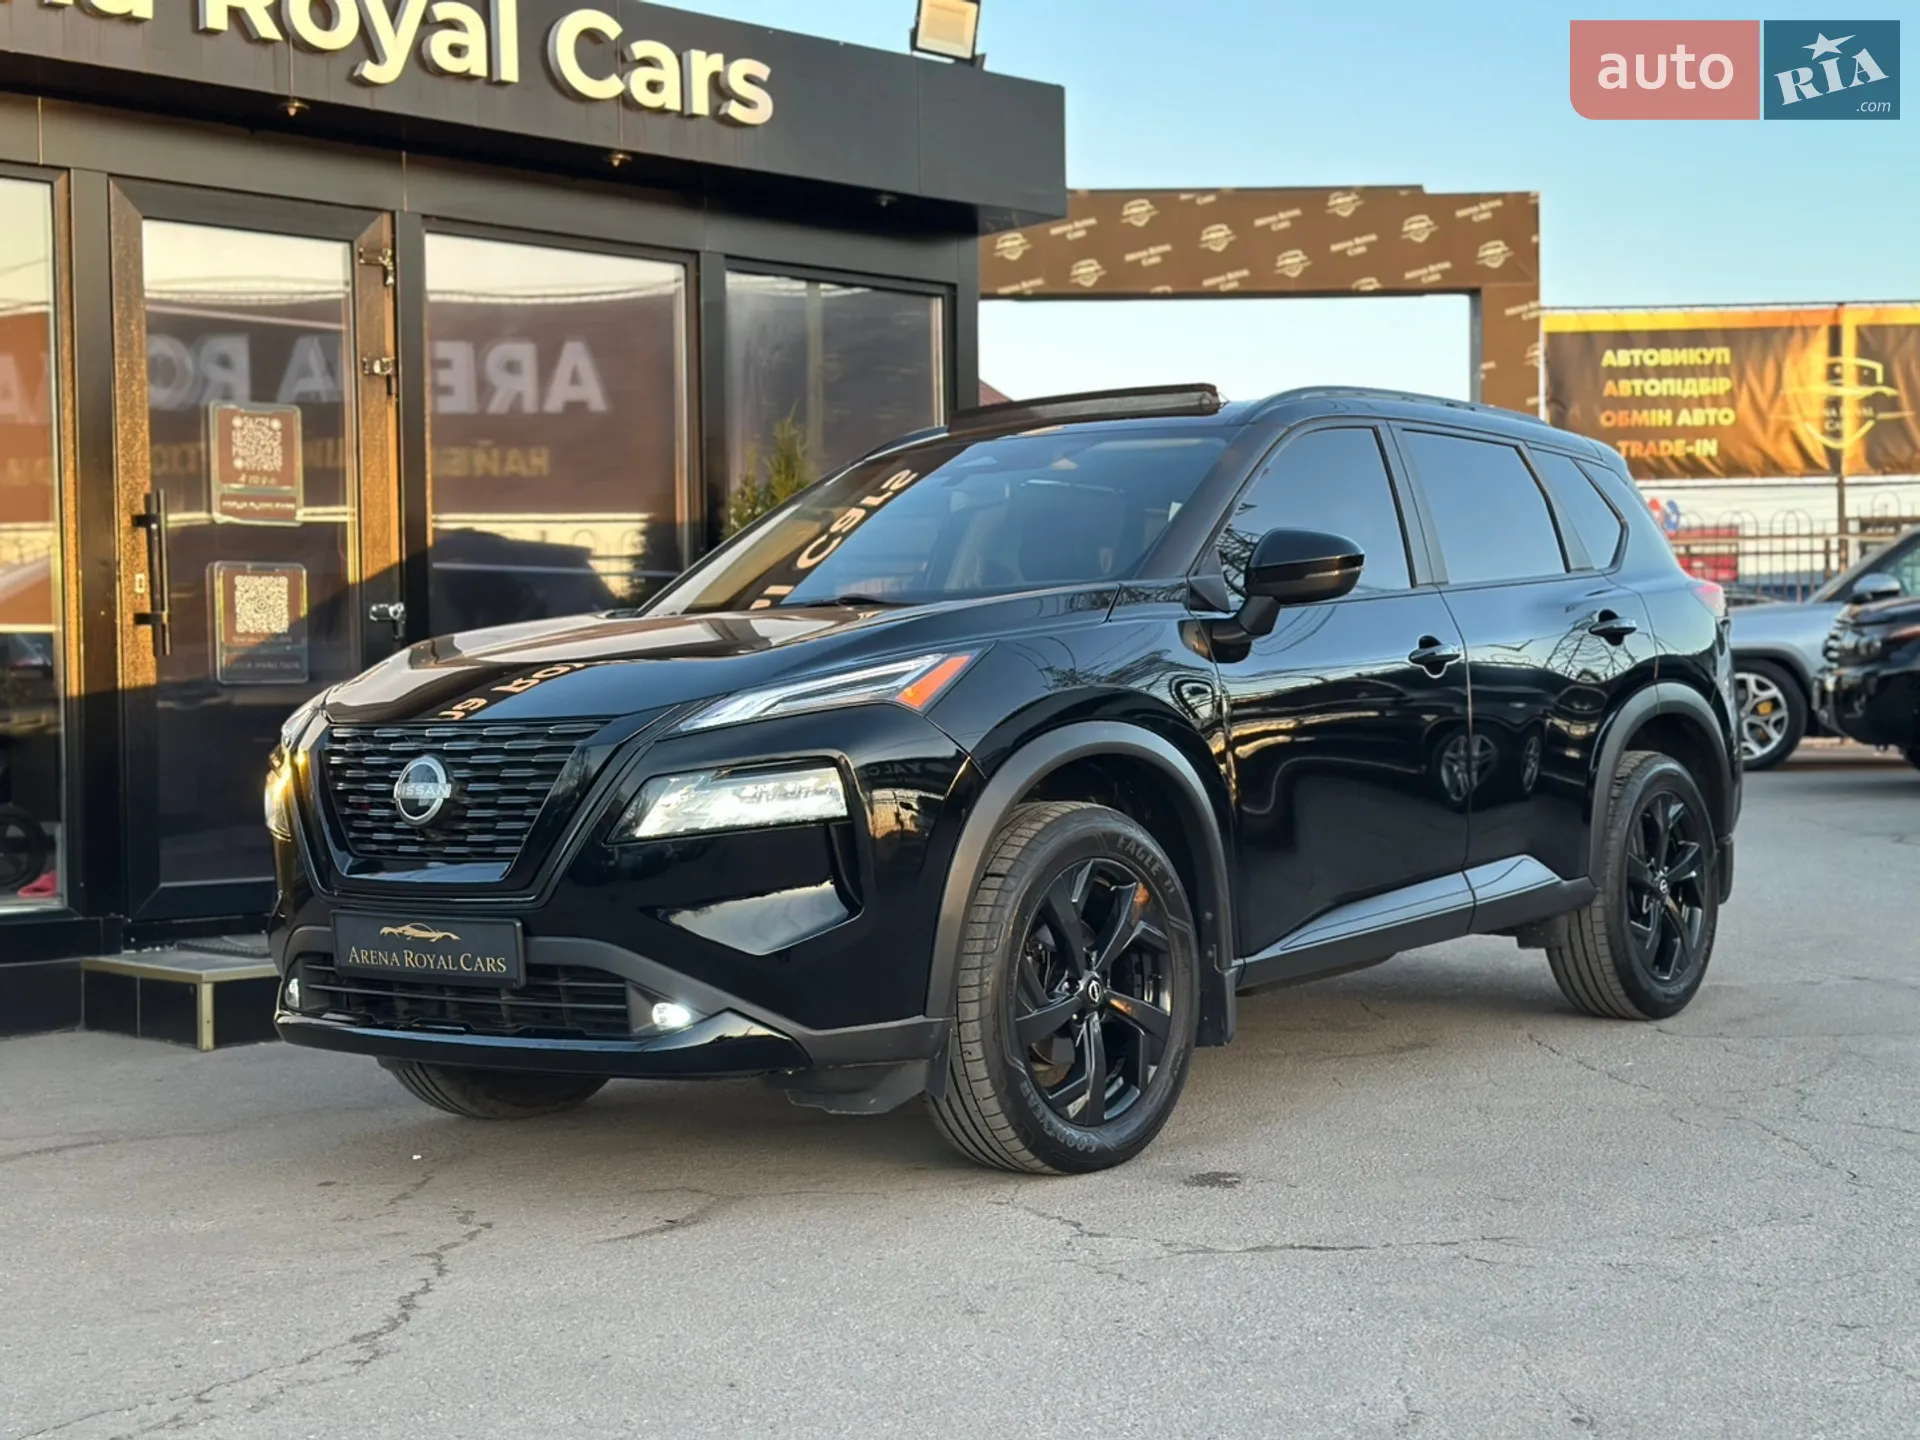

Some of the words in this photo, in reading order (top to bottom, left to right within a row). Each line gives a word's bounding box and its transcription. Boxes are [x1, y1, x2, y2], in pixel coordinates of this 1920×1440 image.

[548, 9, 774, 125] Cars
[1601, 347, 1731, 367] АВТОВИКУП
[1603, 377, 1733, 398] АВТОПІДБІР
[1599, 408, 1673, 428] ОБМІН
[1676, 407, 1736, 426] АВТО
[1616, 438, 1719, 458] TRADE-IN
[349, 945, 401, 968] ARENA
[403, 949, 458, 971] ROYAL
[459, 953, 507, 973] CARS
